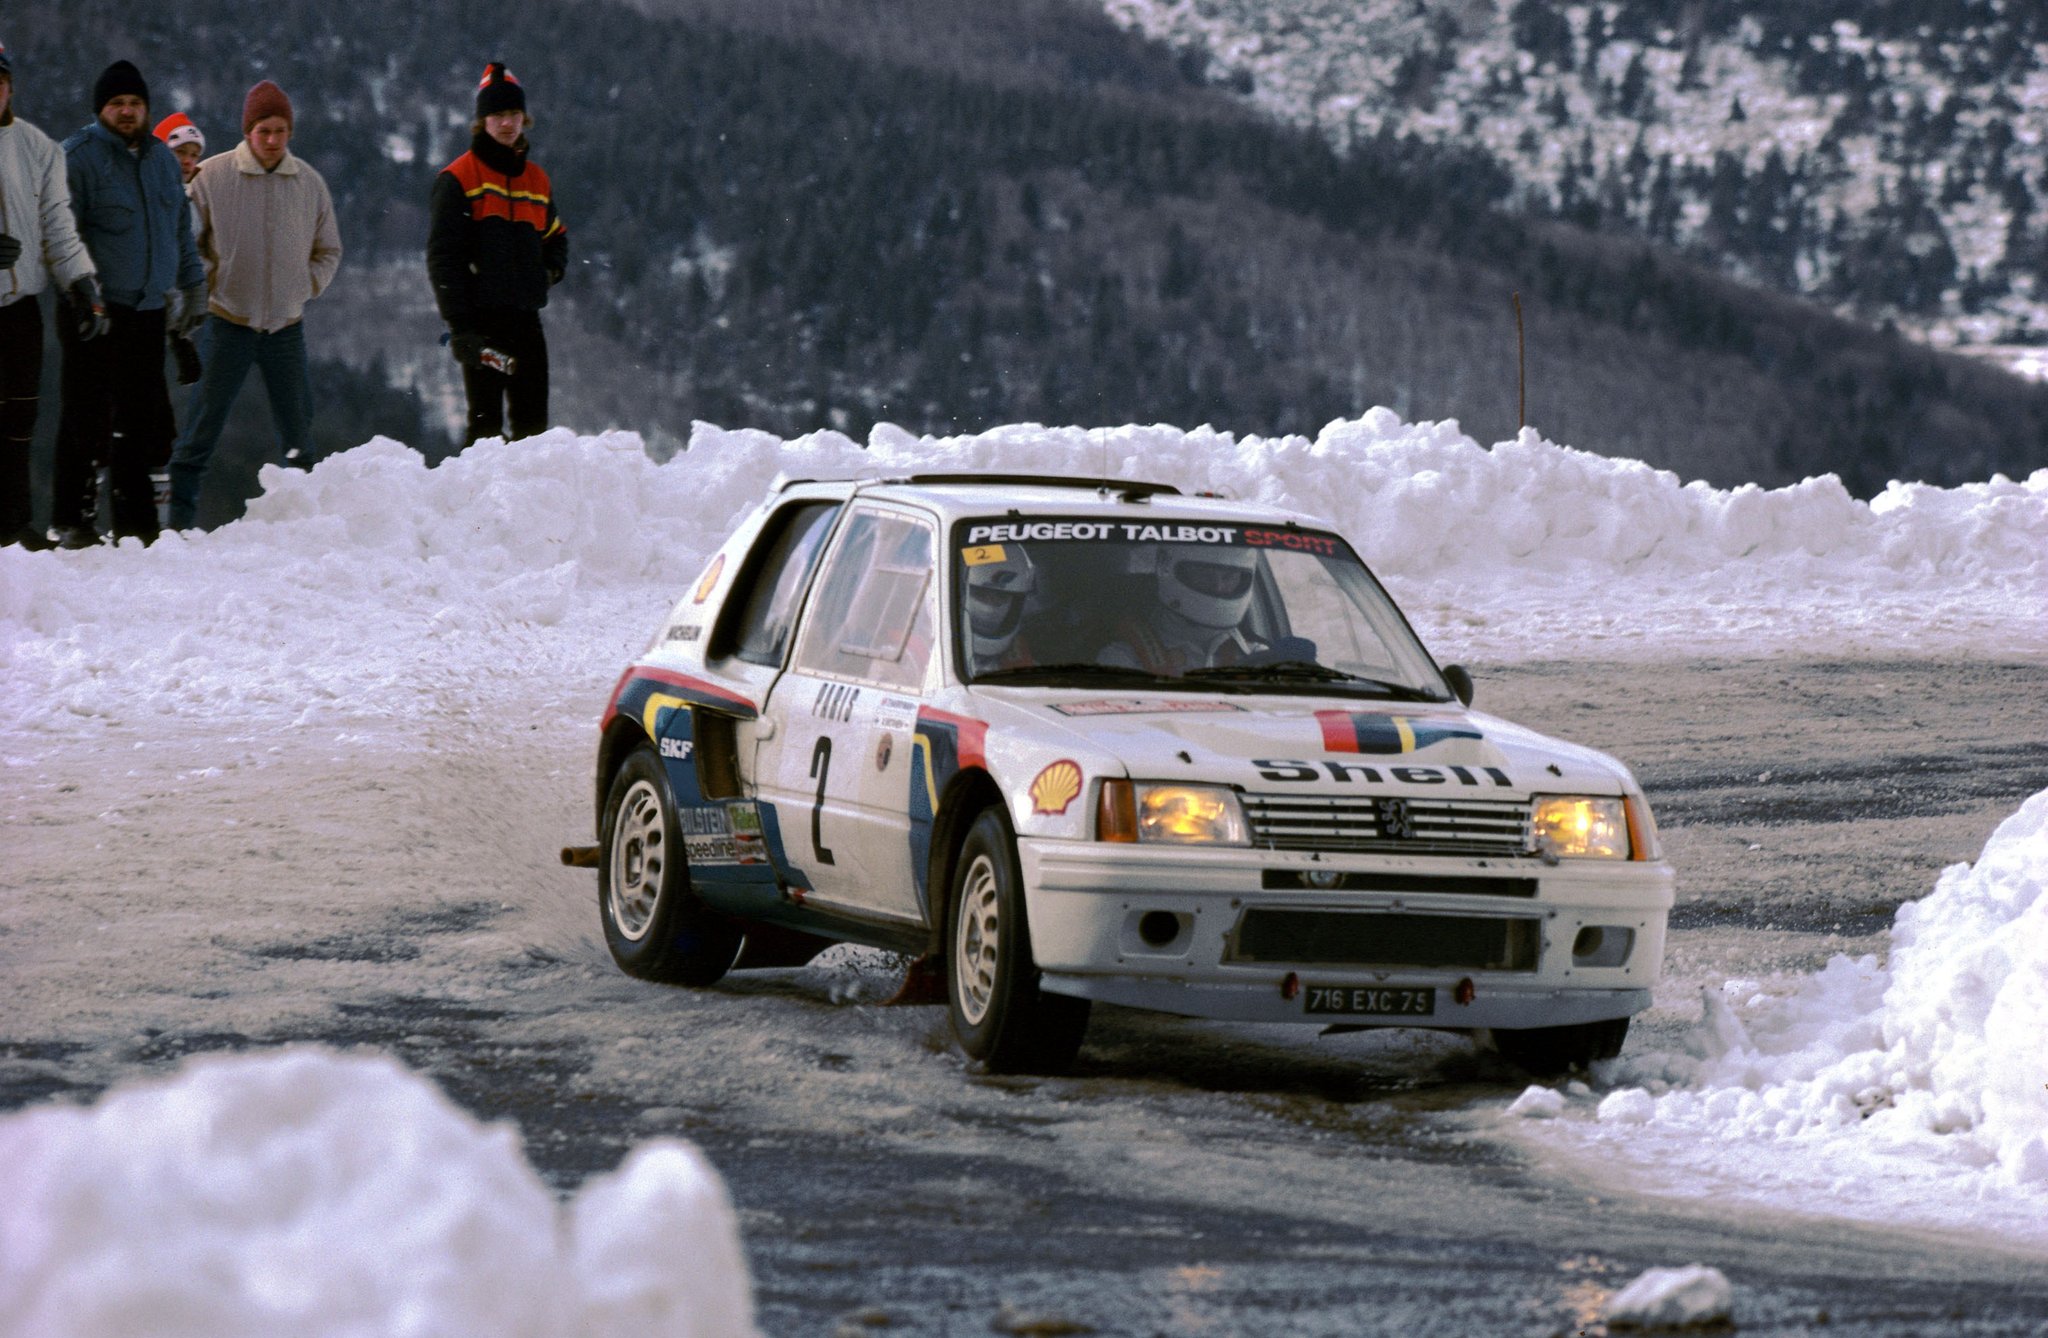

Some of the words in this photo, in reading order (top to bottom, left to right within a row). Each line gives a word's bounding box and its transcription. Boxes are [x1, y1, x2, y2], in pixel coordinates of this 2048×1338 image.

[968, 522, 1115, 544] PEUGEOT
[1121, 524, 1237, 544] TALBOT
[1244, 529, 1336, 556] SPORT
[975, 548, 992, 560] 2
[811, 682, 860, 723] PARIS
[660, 737, 694, 759] SKF
[1251, 759, 1513, 788] Shell
[810, 735, 836, 866] 2
[1311, 989, 1344, 1010] 716
[1352, 990, 1393, 1012] EXC
[1401, 991, 1427, 1013] 75
